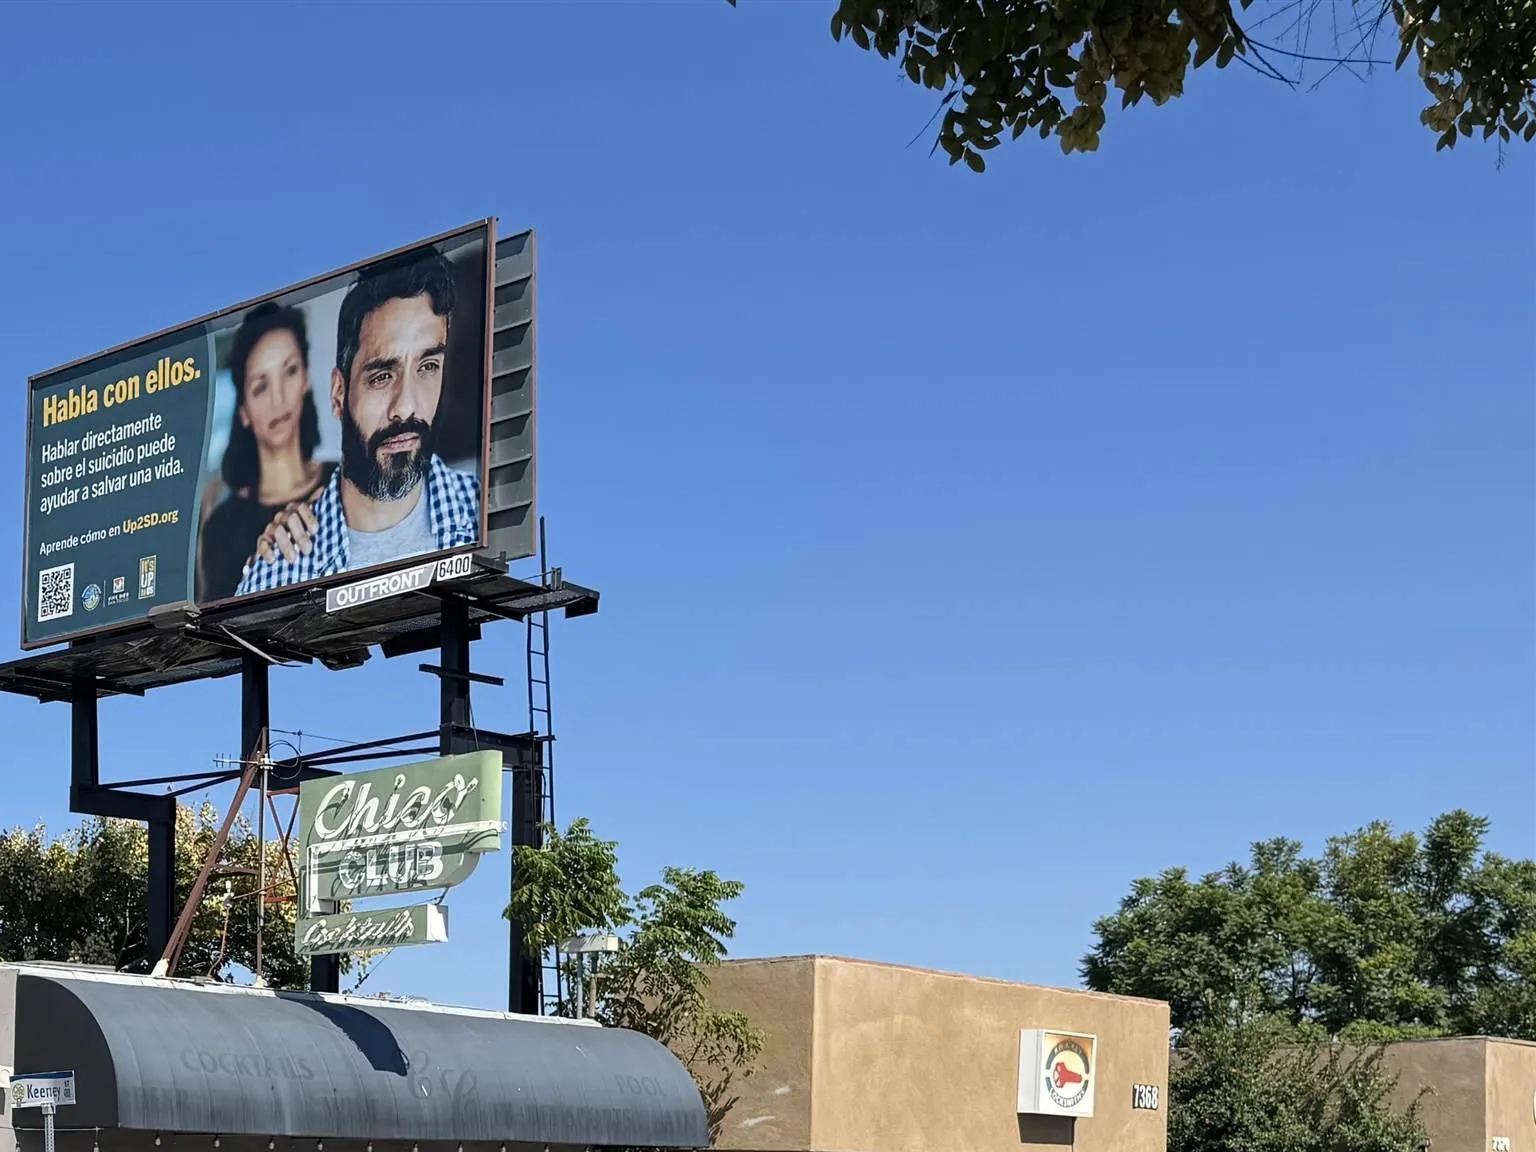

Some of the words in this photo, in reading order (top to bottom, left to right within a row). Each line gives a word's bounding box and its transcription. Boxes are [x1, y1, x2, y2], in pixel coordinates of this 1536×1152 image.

[43, 384, 98, 427] Habla
[103, 375, 140, 408] con
[145, 357, 201, 394] ellos.
[41, 438, 80, 464] Hablar
[81, 413, 162, 451] directamente
[41, 466, 73, 488] sobre
[75, 458, 86, 478] el
[88, 446, 134, 475] suicidio
[137, 433, 176, 464] puede
[40, 487, 80, 515] ayudar
[81, 485, 89, 501] a
[91, 475, 128, 498] salvar
[129, 467, 152, 487] una
[154, 456, 184, 480] vida.
[39, 535, 79, 556] Aprende
[80, 528, 107, 545] cómo
[108, 525, 121, 537] en
[122, 509, 180, 534] Up2SD.org
[141, 571, 154, 588] UP
[336, 569, 425, 606] OUTFRONT
[439, 556, 470, 578] 6400
[314, 773, 479, 839] Chico
[338, 841, 444, 889] CLUB
[182, 1050, 314, 1080] COCKTAILS
[616, 1074, 668, 1097] POOL
[26, 1084, 61, 1102] Keeney
[1134, 1085, 1158, 1109] 7368
